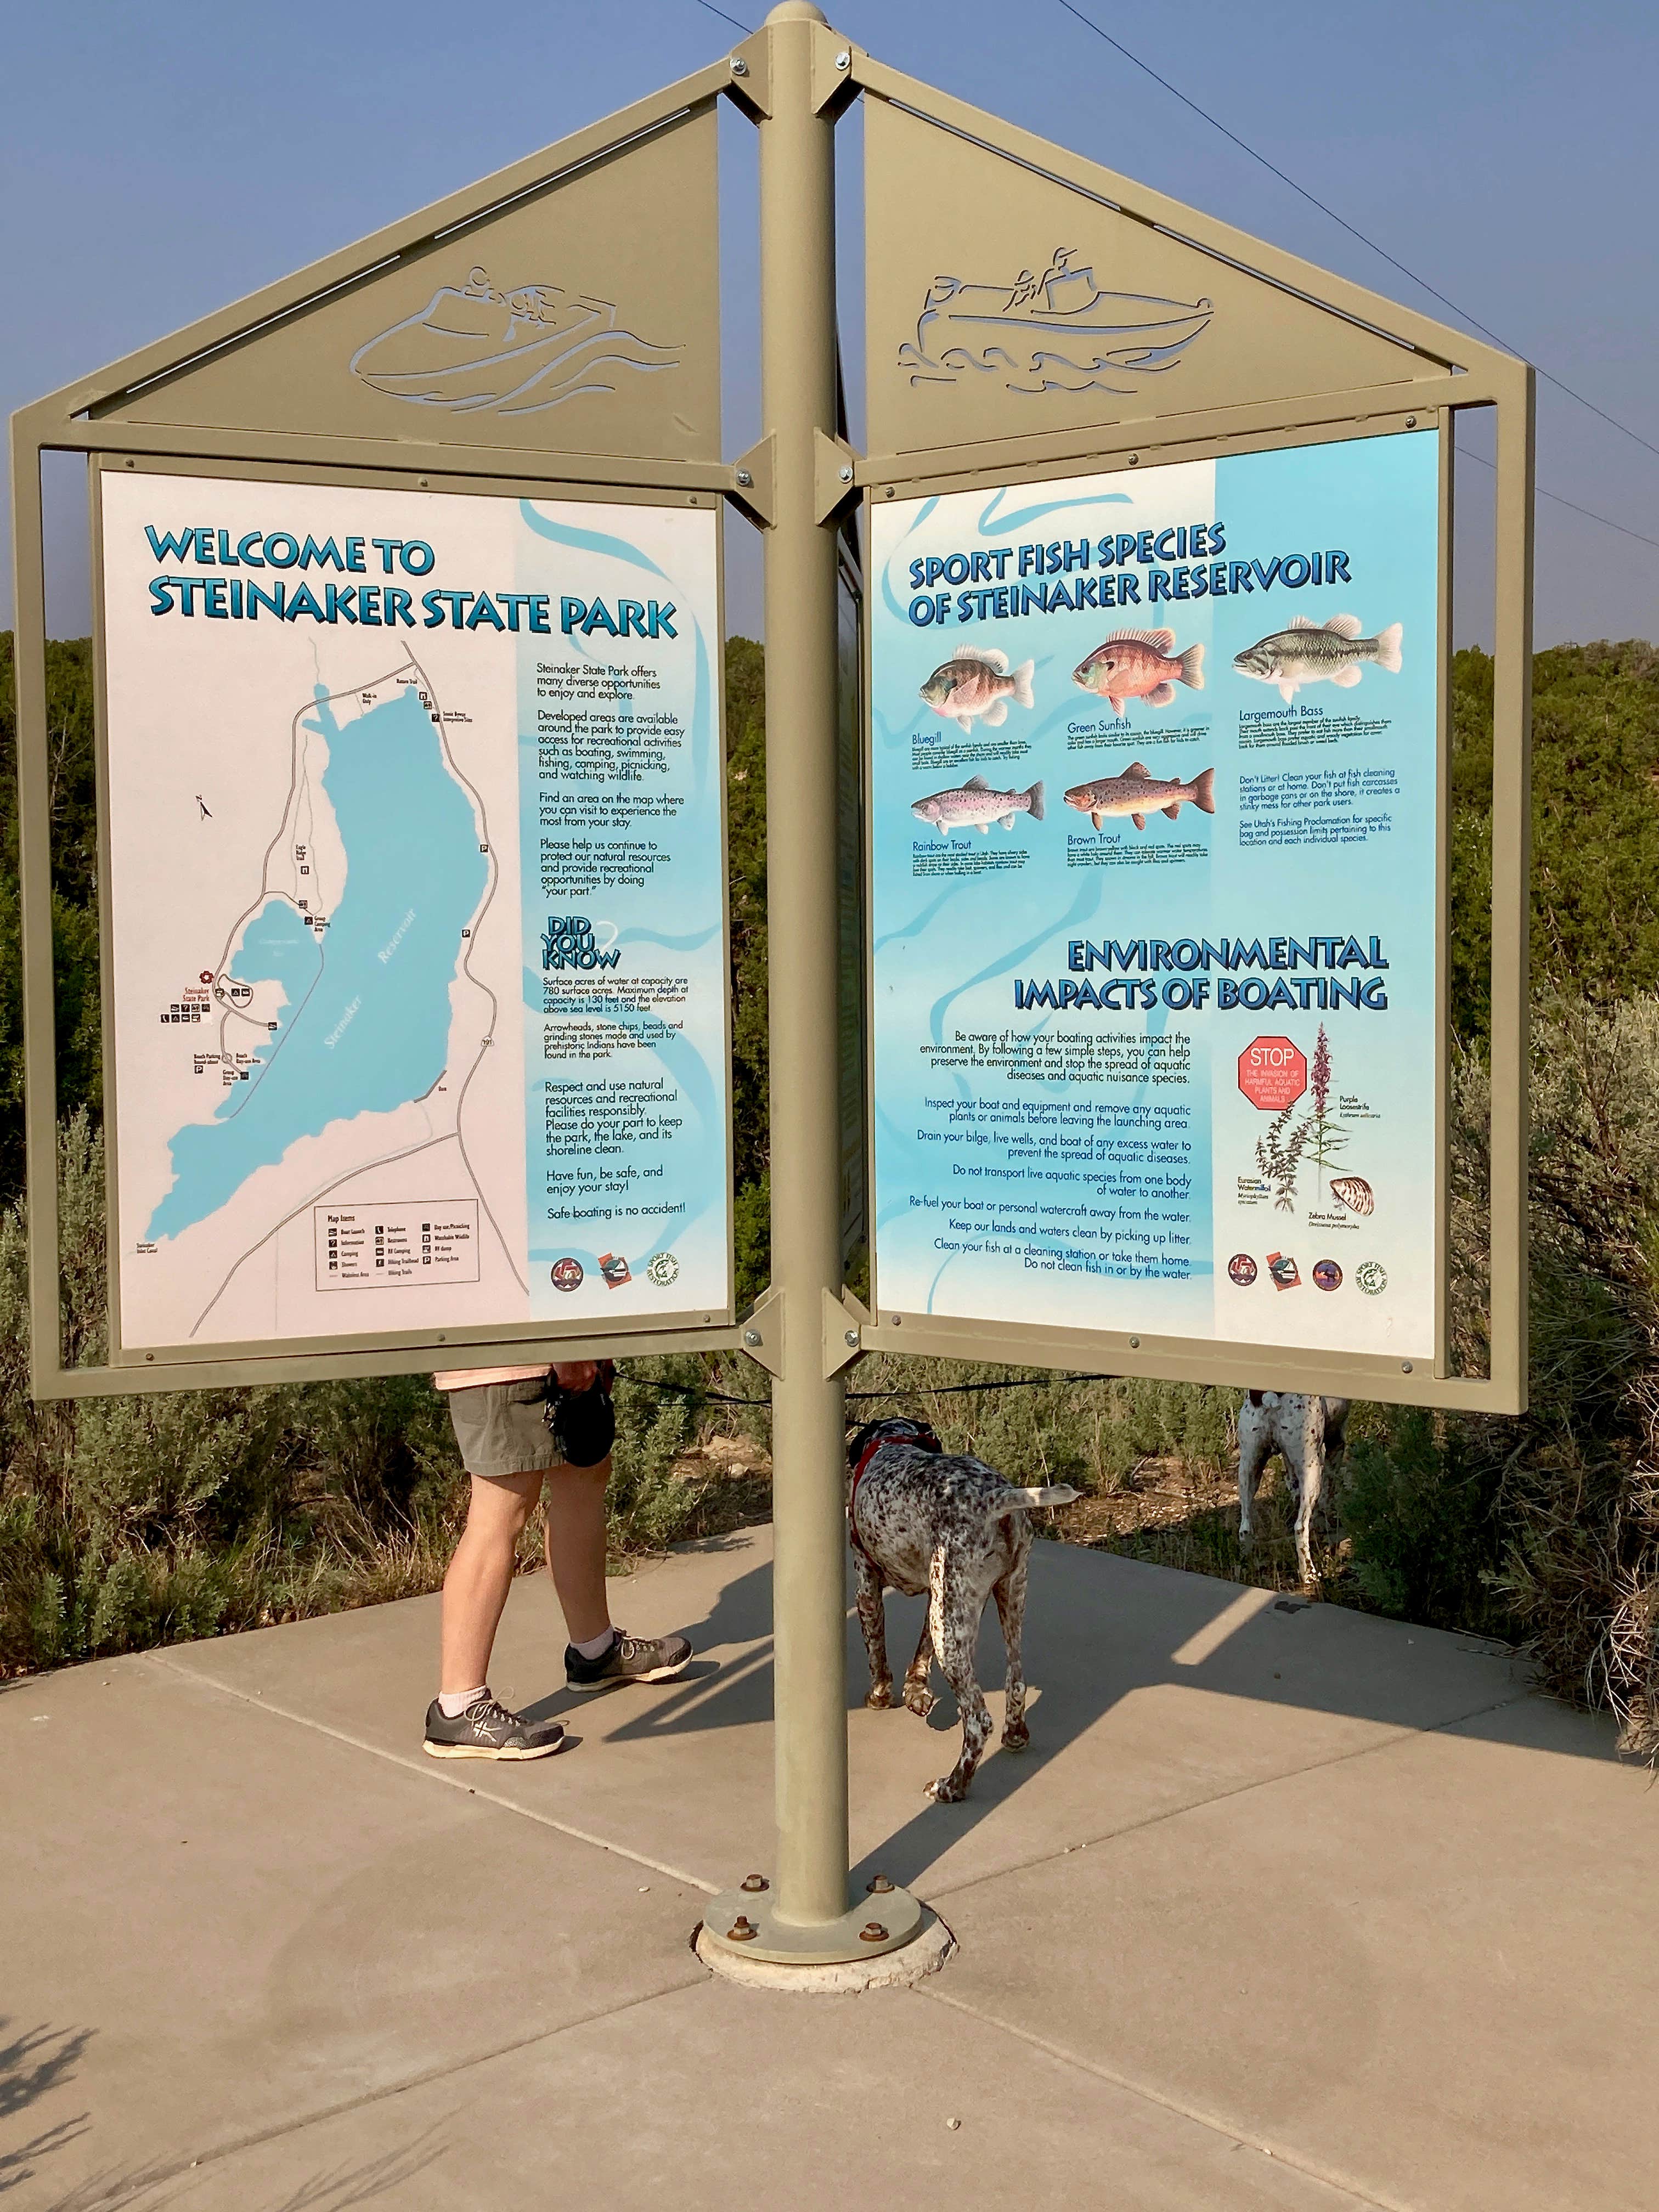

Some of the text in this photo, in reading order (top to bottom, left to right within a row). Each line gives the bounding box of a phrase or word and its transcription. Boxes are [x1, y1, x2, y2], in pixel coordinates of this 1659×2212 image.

[144, 524, 435, 576] WELCOME TO
[909, 522, 1226, 589] SPORT FISH SPECIES
[909, 550, 1352, 627] OF STEINAKER RESERVOIR
[149, 575, 679, 639] STEINAKER STATE PARK
[536, 662, 657, 677] Steinaker State Park offers
[537, 675, 661, 691] many diverse opportunities
[537, 685, 546, 696] to
[548, 689, 575, 701] enjoy
[577, 687, 596, 698] and
[538, 709, 588, 724] Developed
[636, 712, 678, 724] available
[1239, 704, 1323, 723] Largemouth Bass
[537, 722, 686, 738] around the park to provide easy
[1067, 717, 1131, 733] Green Sunfish
[538, 733, 682, 747] access for recreational activities
[912, 730, 941, 747] Bluegill
[538, 745, 560, 756] such
[575, 745, 614, 760] boating,
[616, 747, 666, 761] swimming,
[538, 756, 670, 773] fishing, camping, picnicking,
[1254, 816, 1276, 827] Utah's
[1277, 815, 1302, 828] Fishing
[1304, 814, 1351, 825] Proclamation
[1352, 813, 1363, 823] for
[1364, 812, 1392, 826] specific
[912, 837, 972, 851] Rainbow Trout
[1067, 831, 1121, 845] Brown Trout
[548, 916, 592, 935] DID
[377, 908, 417, 964] Reservoir
[540, 933, 595, 953] YOU
[542, 949, 622, 970] KNOW
[1068, 935, 1390, 972] ENVIRONMENTAL
[543, 994, 576, 1006] capacity
[578, 994, 585, 1003] is
[588, 994, 603, 1003] 130
[620, 993, 636, 1002] and
[638, 993, 650, 1002] the
[1014, 977, 1388, 1011] IMPACTS OF BOATING
[543, 1003, 568, 1013] above
[585, 1003, 603, 1012] level
[605, 1003, 611, 1012] is
[614, 1003, 634, 1012] 5150
[955, 1029, 1190, 1047] Be aware of how your boating activities impact the
[919, 1042, 976, 1054] environment.
[978, 1043, 991, 1058] By
[992, 1043, 1034, 1058] following
[1045, 1043, 1063, 1055] few
[1064, 1044, 1095, 1059] simple
[1097, 1044, 1124, 1059] steps,
[1126, 1048, 1145, 1059] you
[1145, 1048, 1166, 1057] can
[1169, 1045, 1190, 1060] help
[1250, 1047, 1294, 1066] STOP
[930, 1055, 1191, 1073] preserve the environment and stop the spread of aquatic
[1007, 1068, 1190, 1086] diseases and aquatic nuisance species.
[1261, 1069, 1288, 1077] INVASION
[1339, 1094, 1358, 1104] Purple
[546, 1164, 663, 1181] Have fun, be safe, and
[547, 1180, 629, 1197] enjoy your stay!
[547, 1201, 686, 1220] Safe boating is no accident!
[949, 1218, 972, 1234] Keep
[974, 1223, 990, 1232] our
[992, 1221, 1017, 1233] lands
[1018, 1223, 1037, 1234] and
[1039, 1224, 1070, 1237] waters
[1070, 1226, 1097, 1238] clean
[1100, 1227, 1113, 1243] by
[1115, 1228, 1150, 1245] picking
[1153, 1234, 1166, 1246] up
